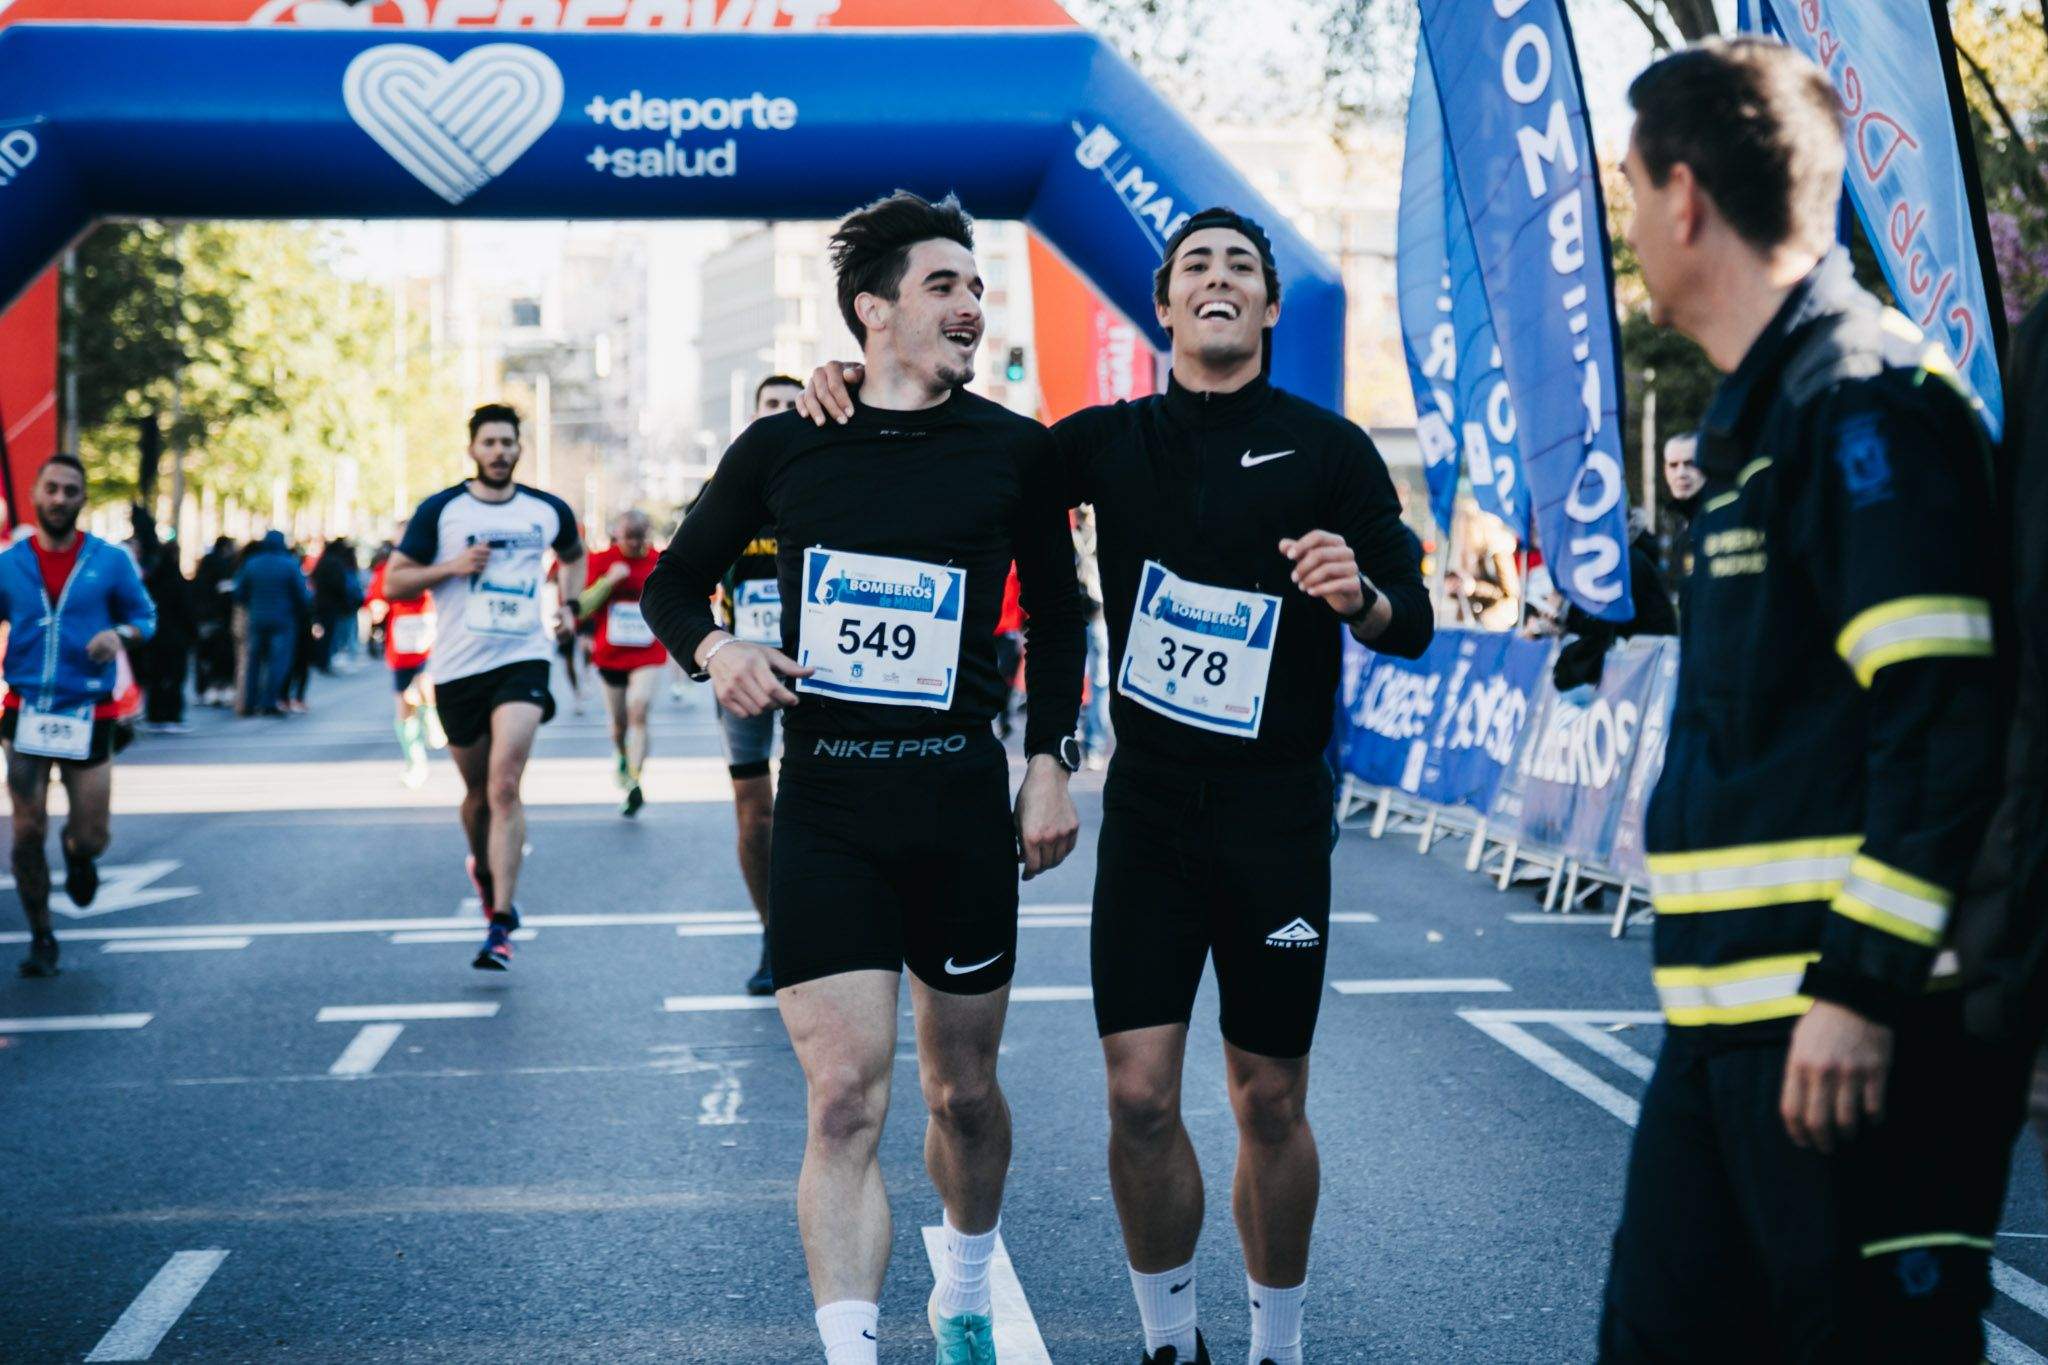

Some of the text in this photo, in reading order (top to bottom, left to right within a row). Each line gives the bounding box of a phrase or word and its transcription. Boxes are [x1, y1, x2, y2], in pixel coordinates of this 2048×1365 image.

[850, 579, 932, 600] BOMBEROS
[837, 618, 916, 660] 549
[1157, 636, 1228, 685] 378
[813, 735, 967, 758] NIKE PRO
